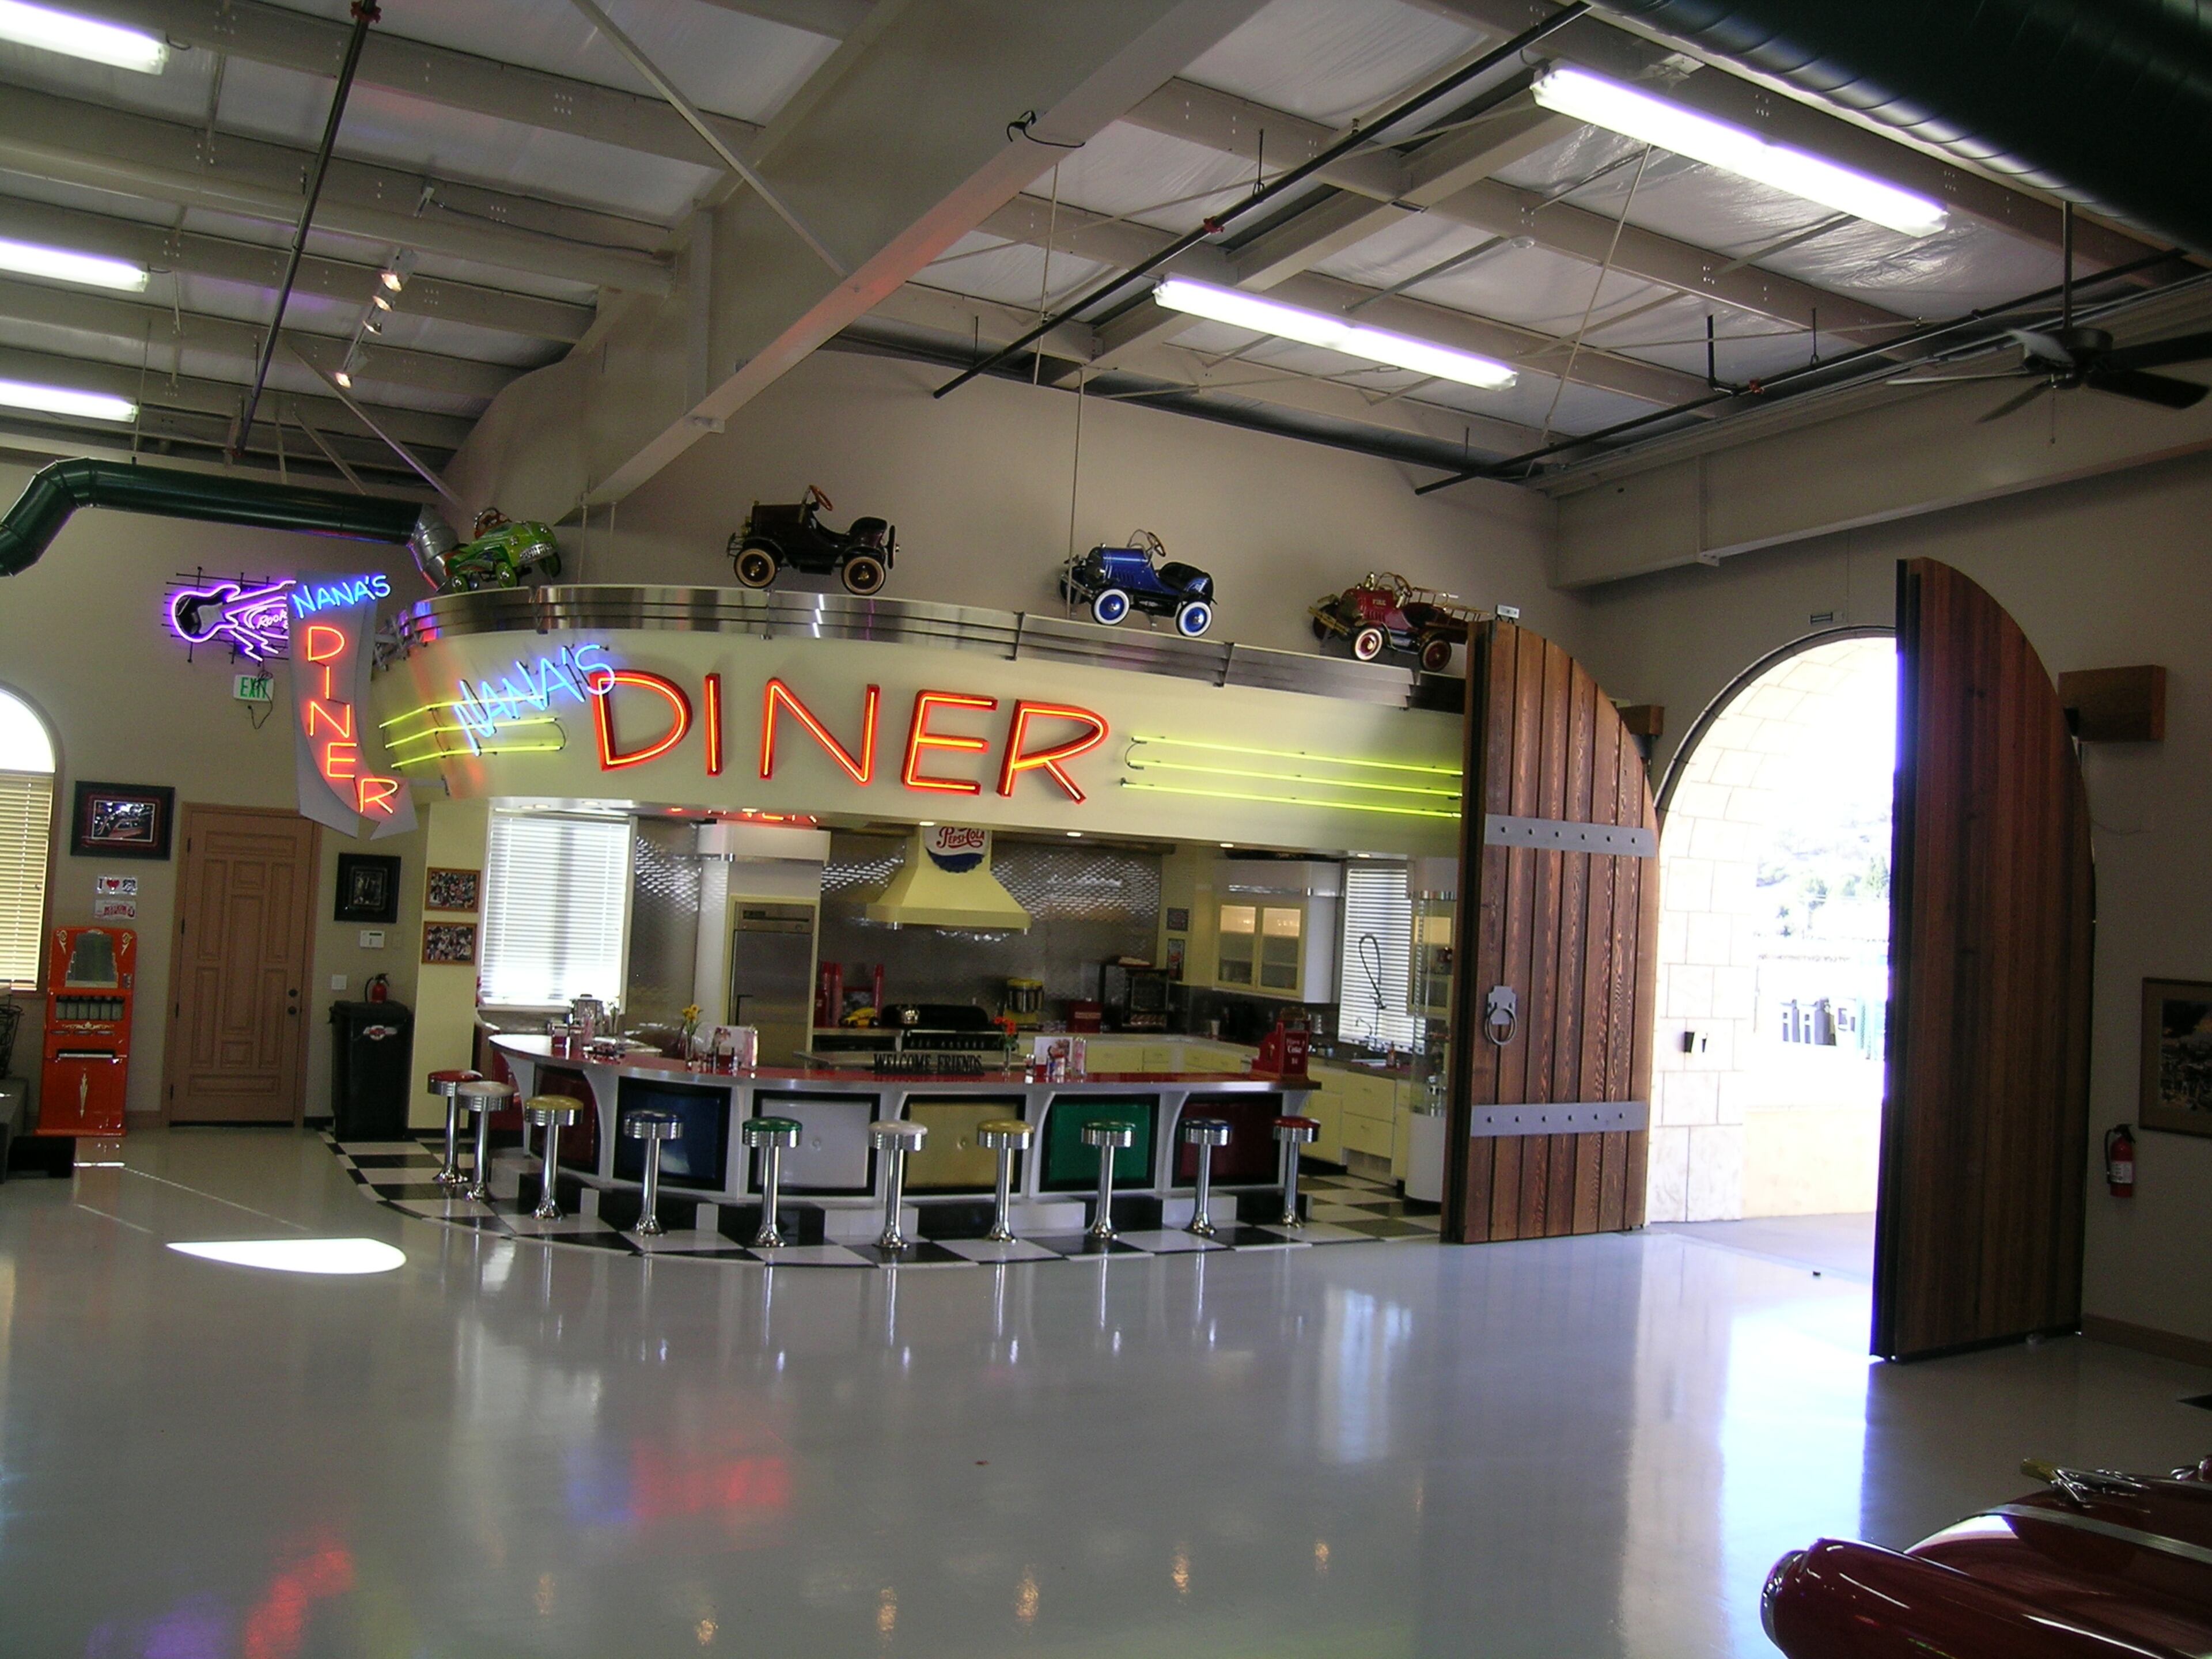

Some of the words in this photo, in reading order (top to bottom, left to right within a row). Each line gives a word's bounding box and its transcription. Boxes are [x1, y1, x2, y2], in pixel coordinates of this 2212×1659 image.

[292, 574, 391, 619] NANA'S
[239, 676, 268, 699] EXIT
[306, 625, 399, 814] DINER
[453, 643, 615, 757] NANA'S
[589, 668, 1109, 805] DINER
[873, 1053, 931, 1070] WELCOME
[937, 1054, 983, 1073] FRIENDS
